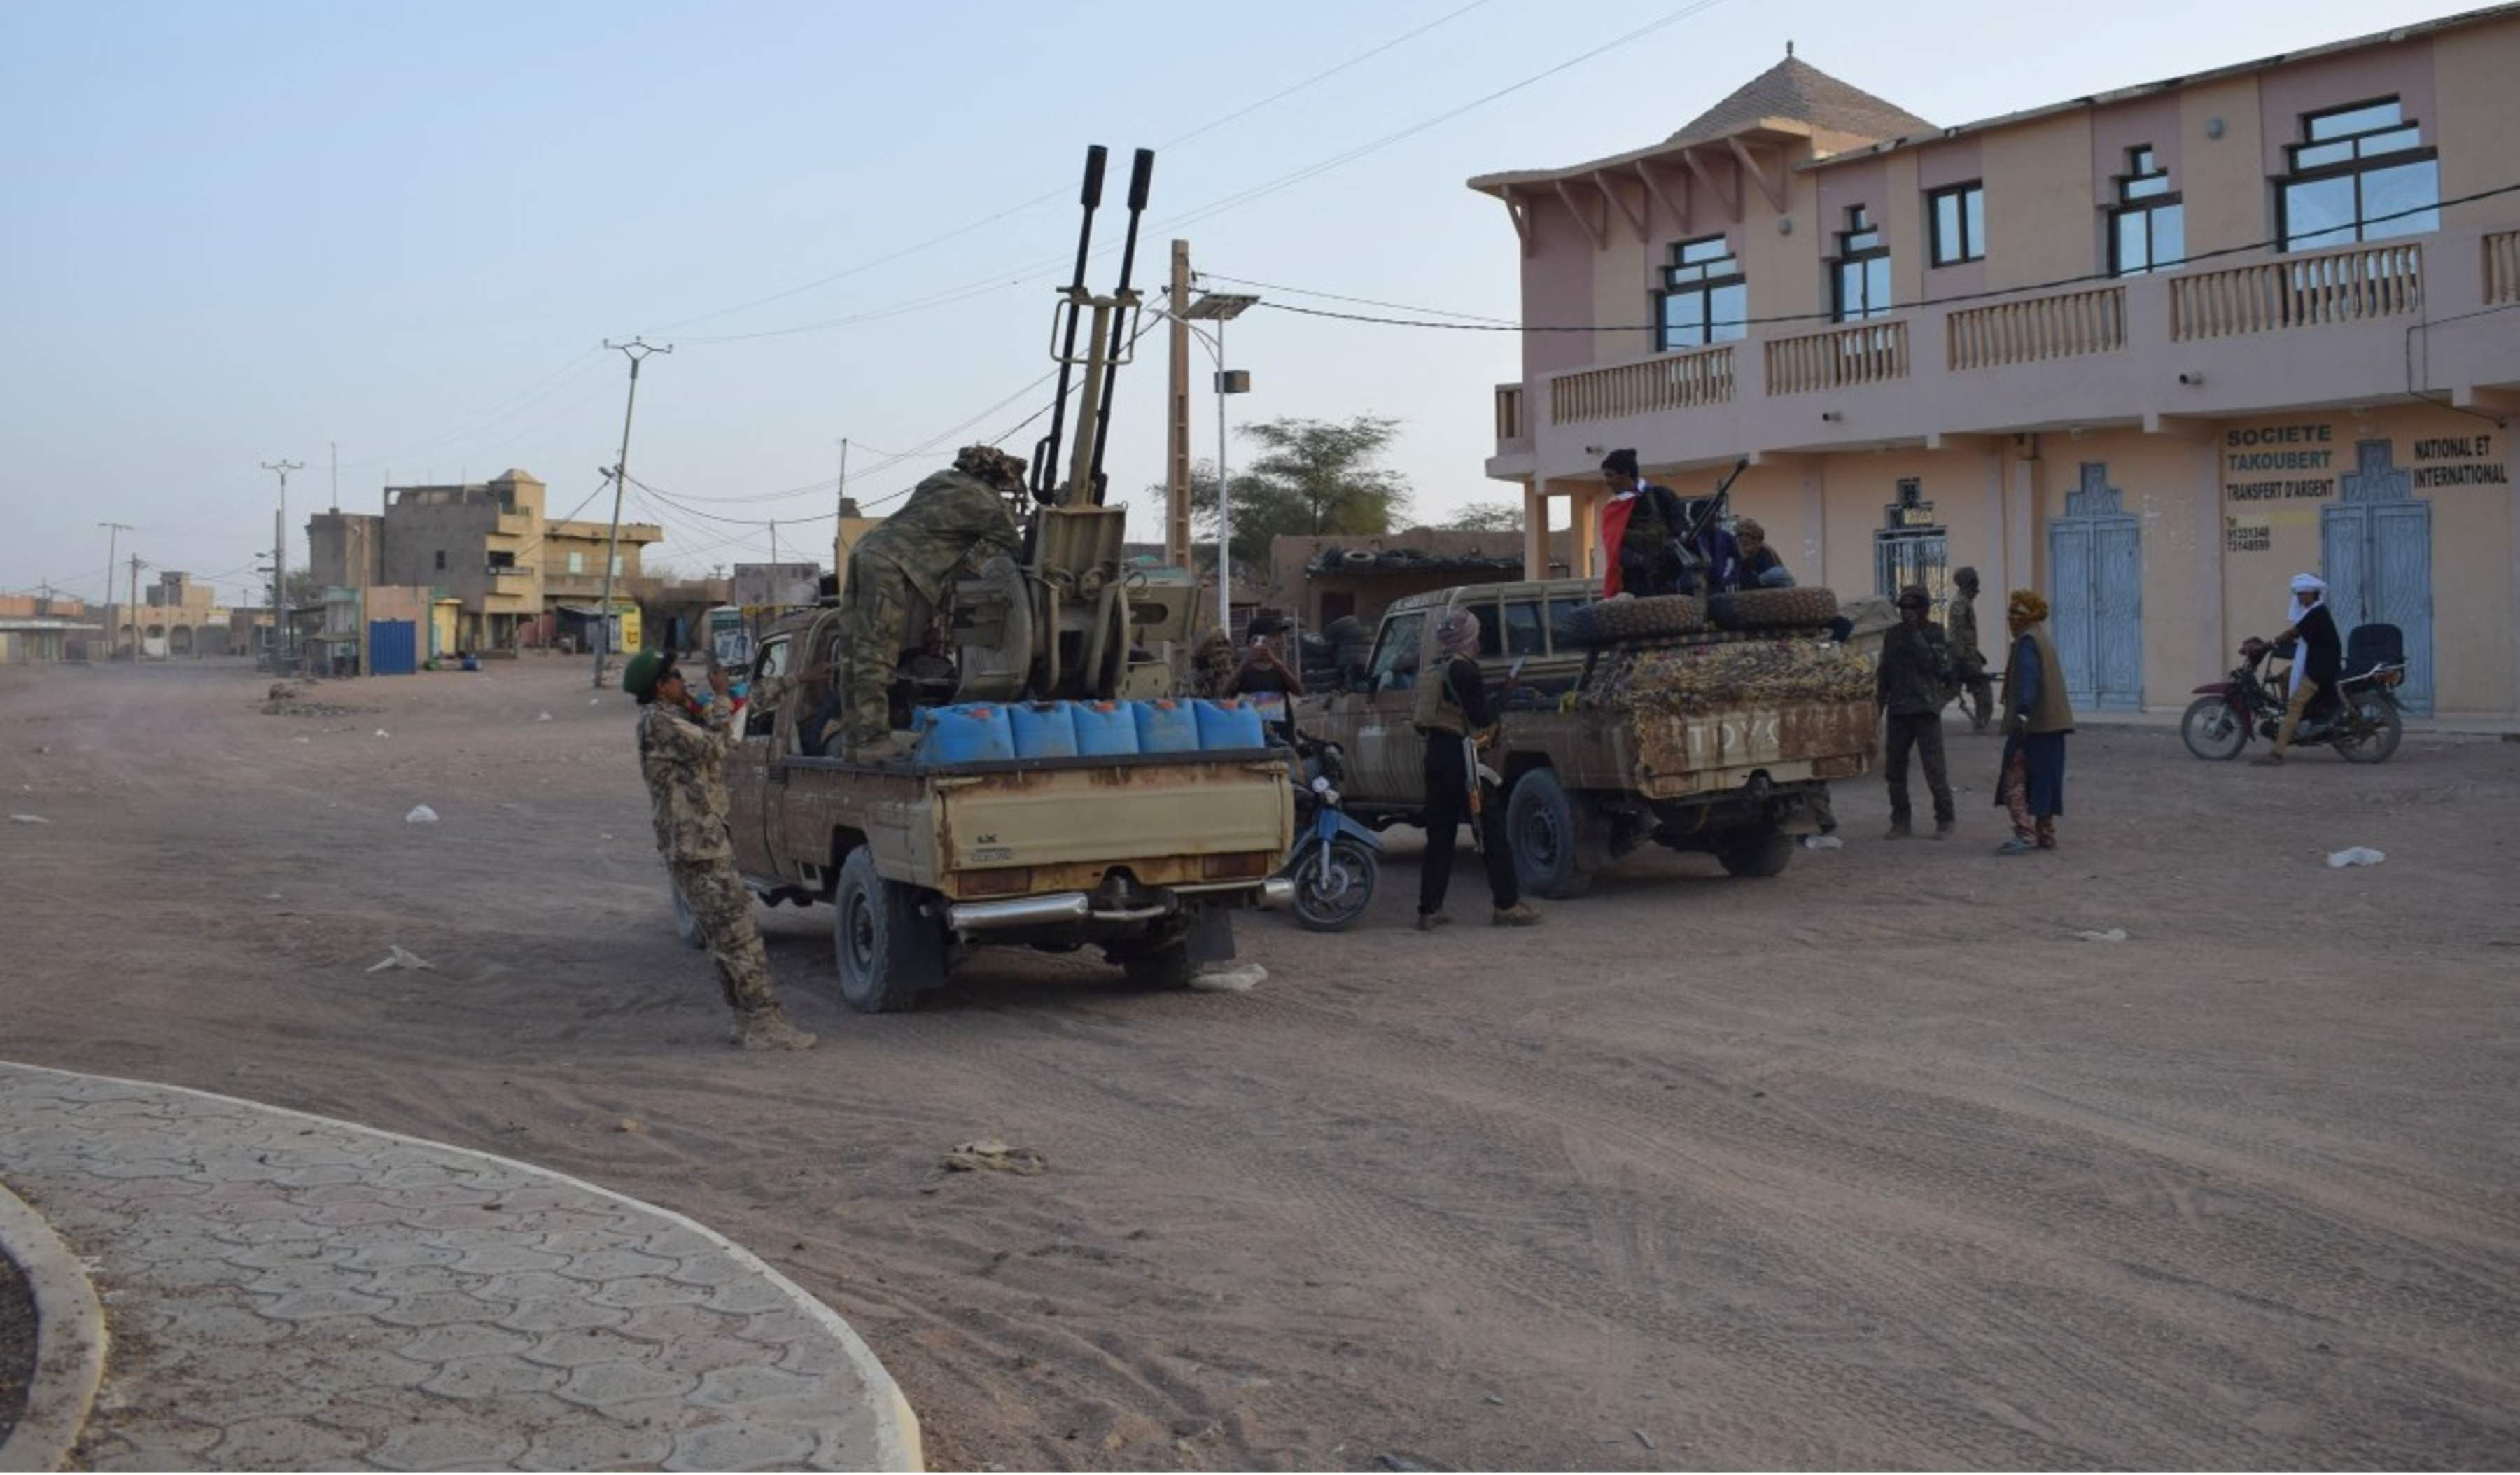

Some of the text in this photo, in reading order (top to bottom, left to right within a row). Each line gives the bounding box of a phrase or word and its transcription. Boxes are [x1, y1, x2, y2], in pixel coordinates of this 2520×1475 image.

[2227, 424, 2332, 447] SOCIETE
[2414, 435, 2491, 461] NATIONAL ET
[2227, 449, 2333, 471] TAKOUBERT
[2414, 463, 2507, 489] INTERNATIONAL
[2226, 478, 2334, 501] TRANSFERT D'ARGENT
